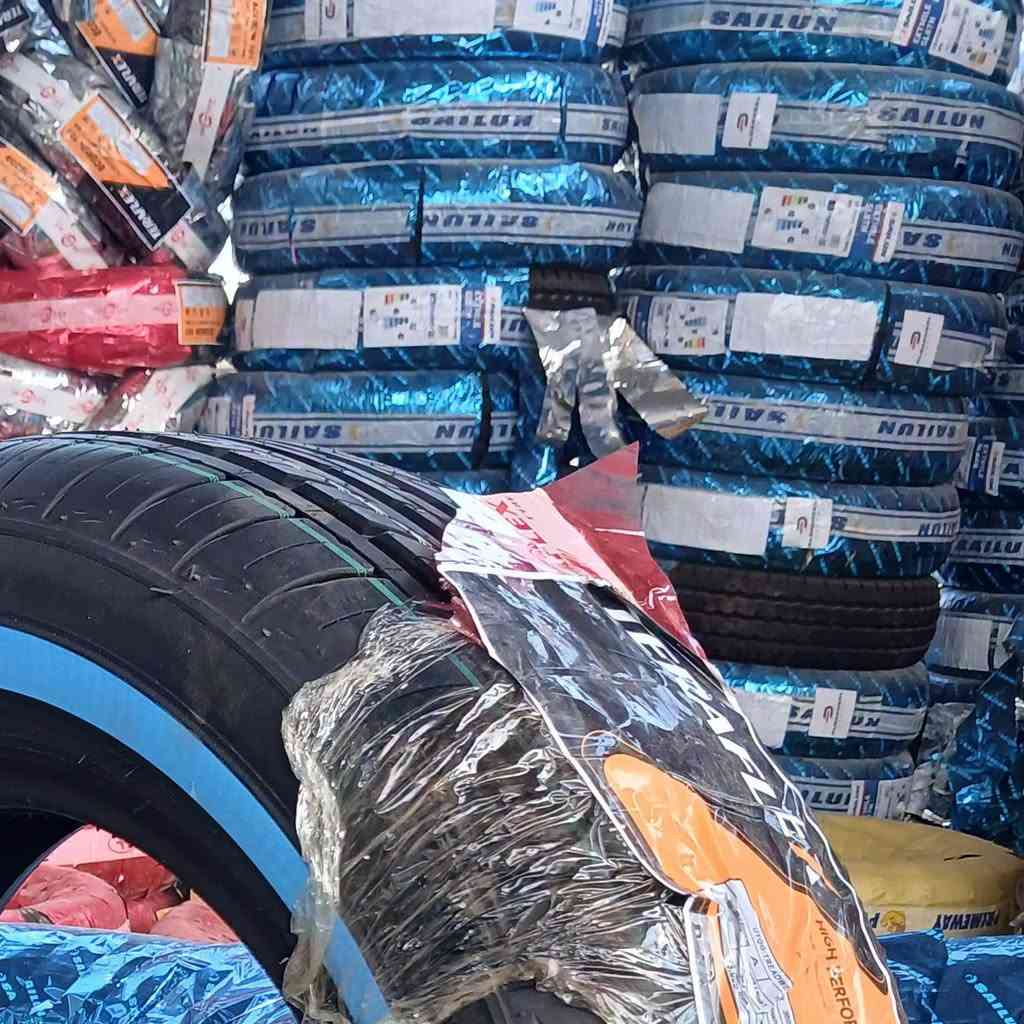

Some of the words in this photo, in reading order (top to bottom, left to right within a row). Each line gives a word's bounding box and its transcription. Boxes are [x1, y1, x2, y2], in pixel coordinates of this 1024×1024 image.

[710, 10, 837, 31] SAILUN
[877, 107, 985, 128] SAILUN
[714, 405, 787, 424] SAIL
[254, 424, 343, 439] SAILU
[790, 706, 880, 727] SAUN
[816, 920, 838, 960] HIGH
